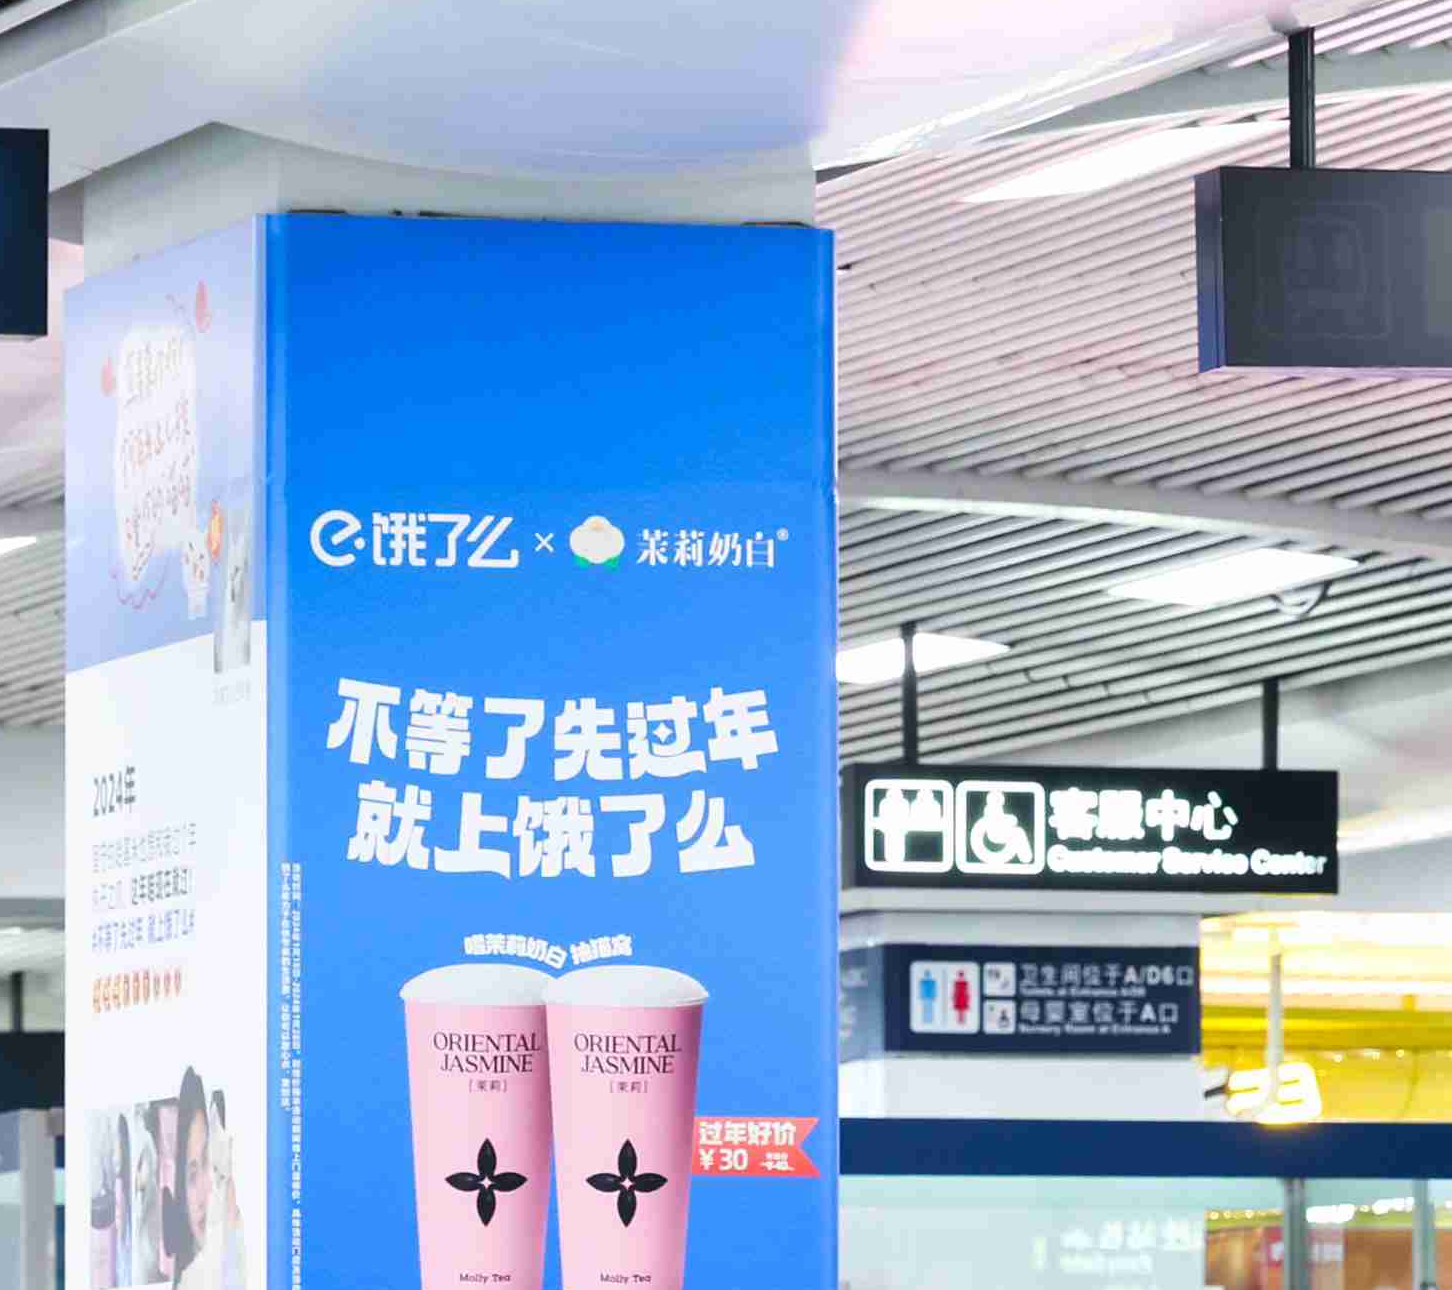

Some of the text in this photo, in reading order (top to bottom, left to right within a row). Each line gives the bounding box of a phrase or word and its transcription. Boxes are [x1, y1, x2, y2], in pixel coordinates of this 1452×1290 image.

[326, 678, 779, 782] 不等了先过年
[1048, 787, 1238, 841] 客服中心
[347, 780, 756, 880] 就上饿了么
[1250, 847, 1328, 876] Center
[432, 1030, 542, 1053] ORIENTAL
[573, 1031, 683, 1054] ORIENTAL
[439, 1054, 534, 1075] JASMINE
[580, 1055, 675, 1076] JASMINE
[697, 1120, 797, 1147] 过年好价
[458, 1272, 512, 1285] Molly Tea
[599, 1272, 652, 1285] Molly Tea
